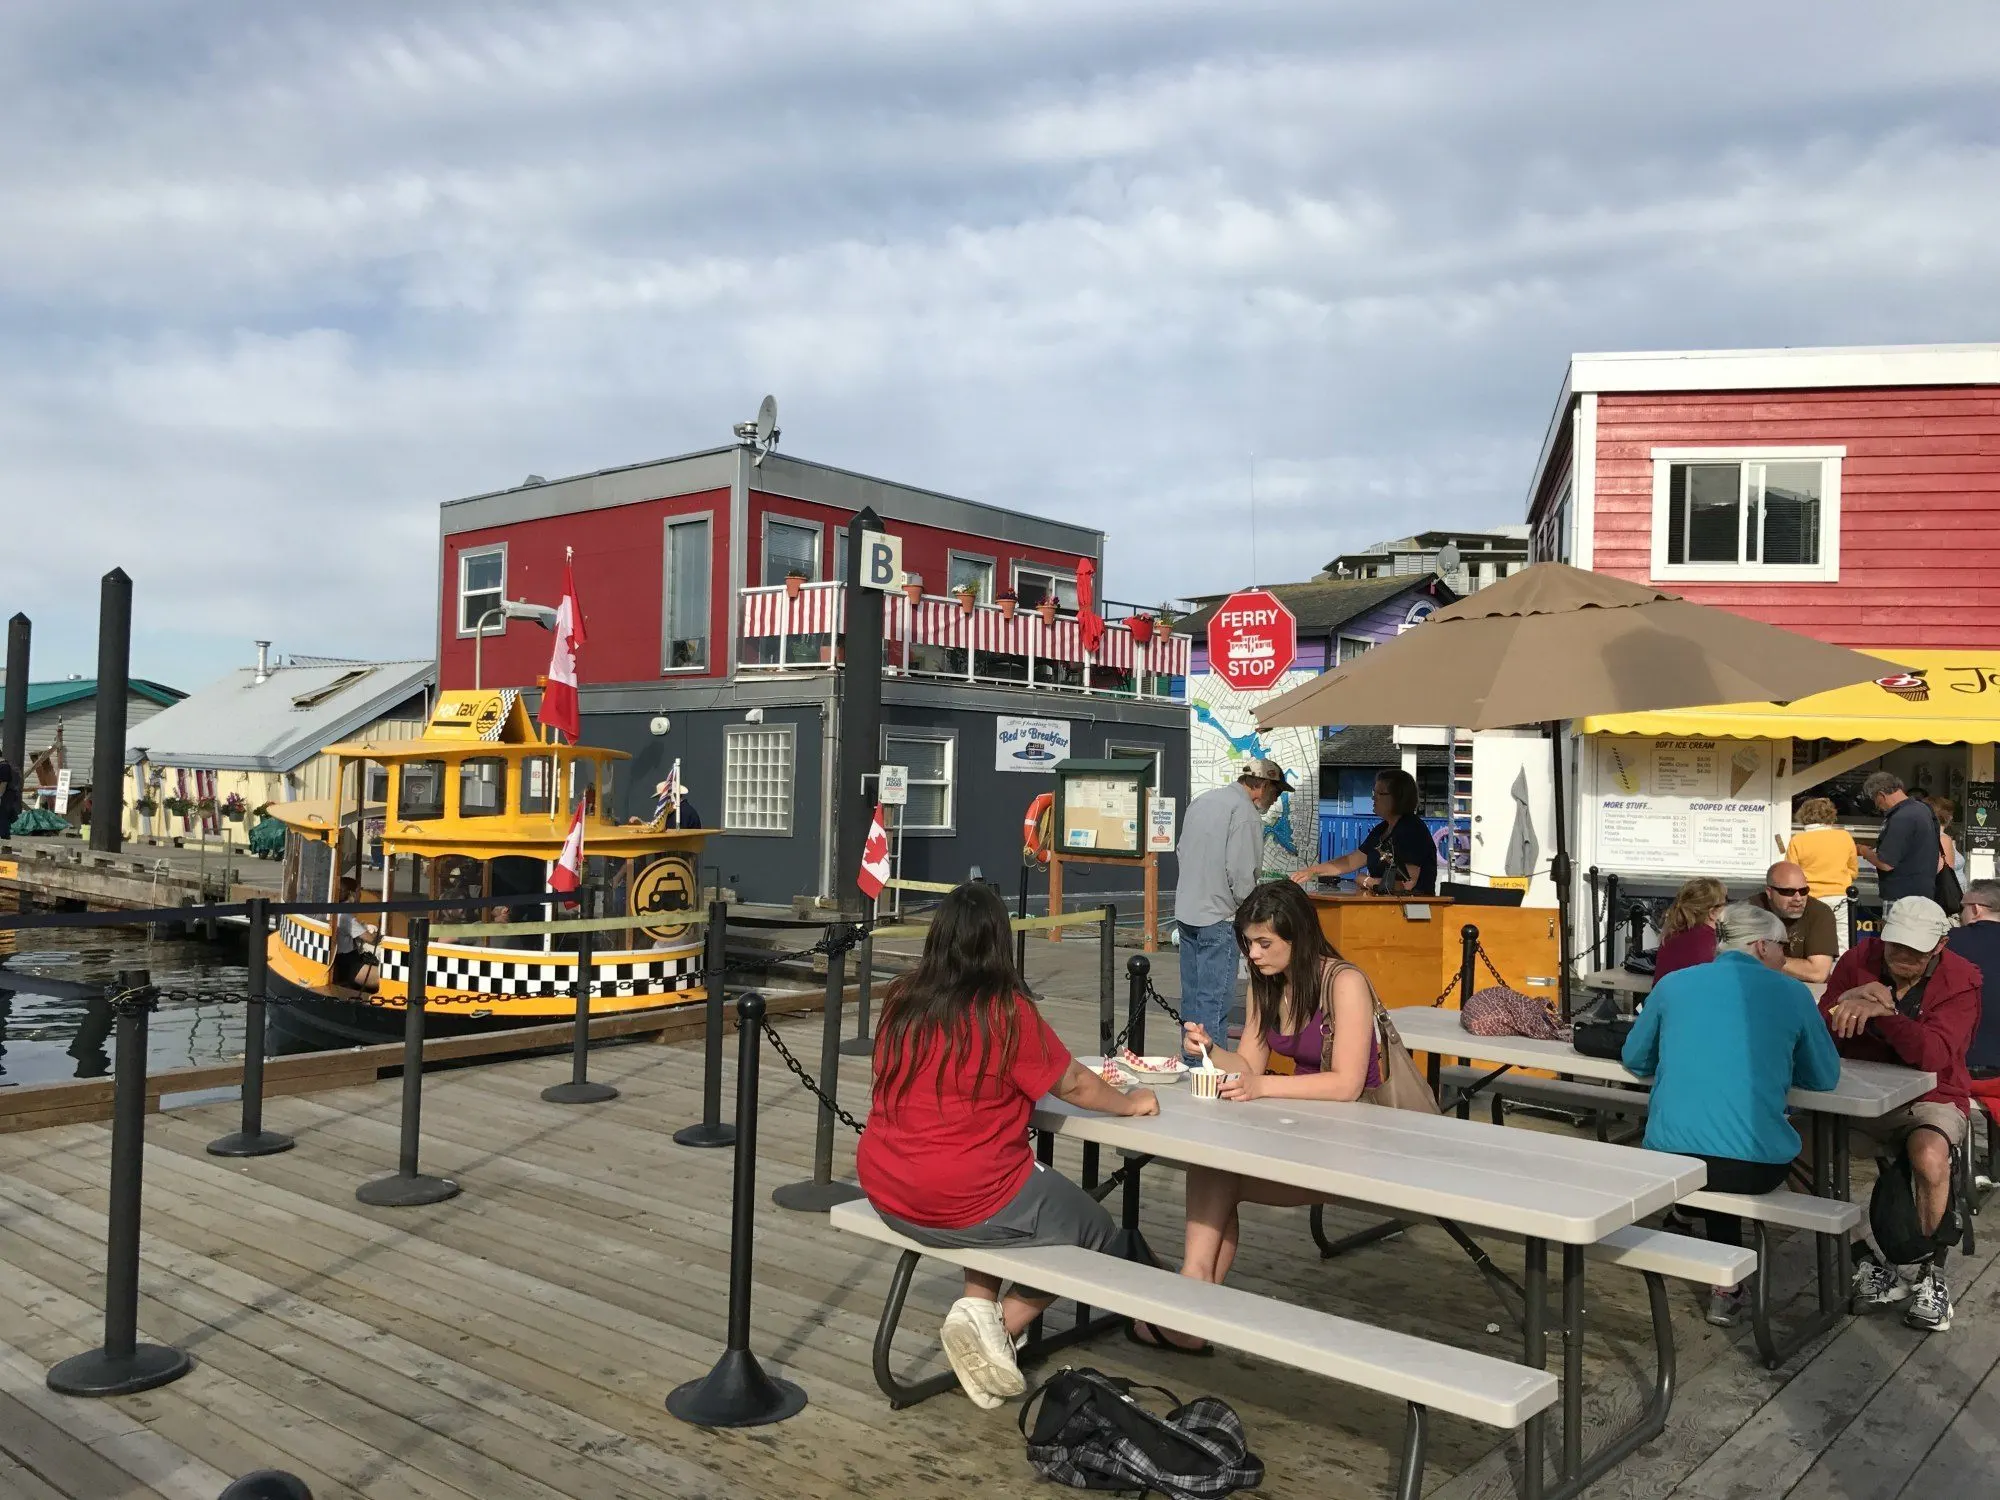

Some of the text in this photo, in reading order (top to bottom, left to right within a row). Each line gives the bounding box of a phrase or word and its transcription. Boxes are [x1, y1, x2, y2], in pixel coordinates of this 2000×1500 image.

[871, 543, 893, 584] B
[1221, 609, 1278, 628] FERRY
[1228, 660, 1275, 676] STOP
[999, 728, 1018, 743] Bed
[1028, 728, 1068, 747] Breakfast
[1973, 790, 1991, 798] THE
